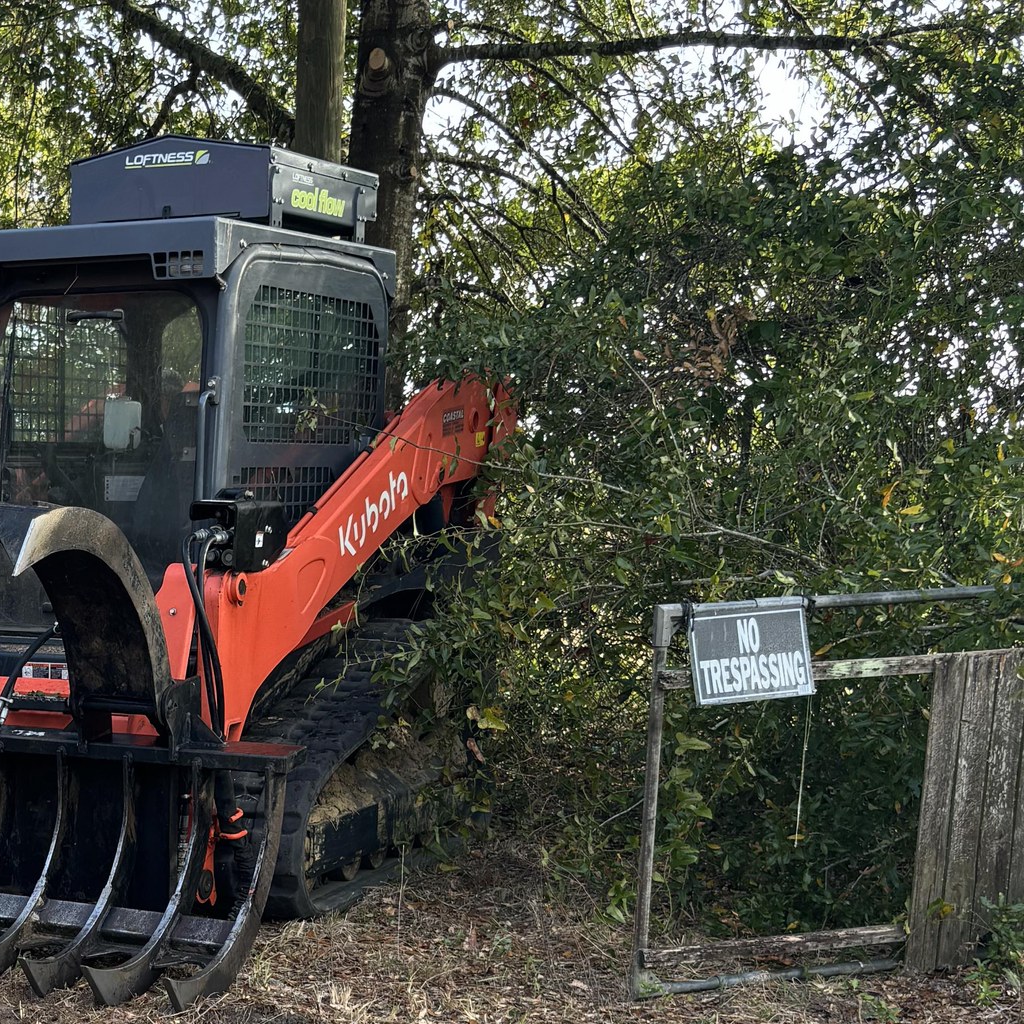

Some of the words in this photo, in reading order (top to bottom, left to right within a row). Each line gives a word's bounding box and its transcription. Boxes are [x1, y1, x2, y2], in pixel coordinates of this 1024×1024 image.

[125, 151, 195, 166] LOFTNESS
[291, 187, 320, 211] cool
[318, 189, 346, 217] flow
[338, 470, 409, 557] Kubota
[736, 617, 760, 654] NO
[699, 650, 807, 695] TRESPASSING
